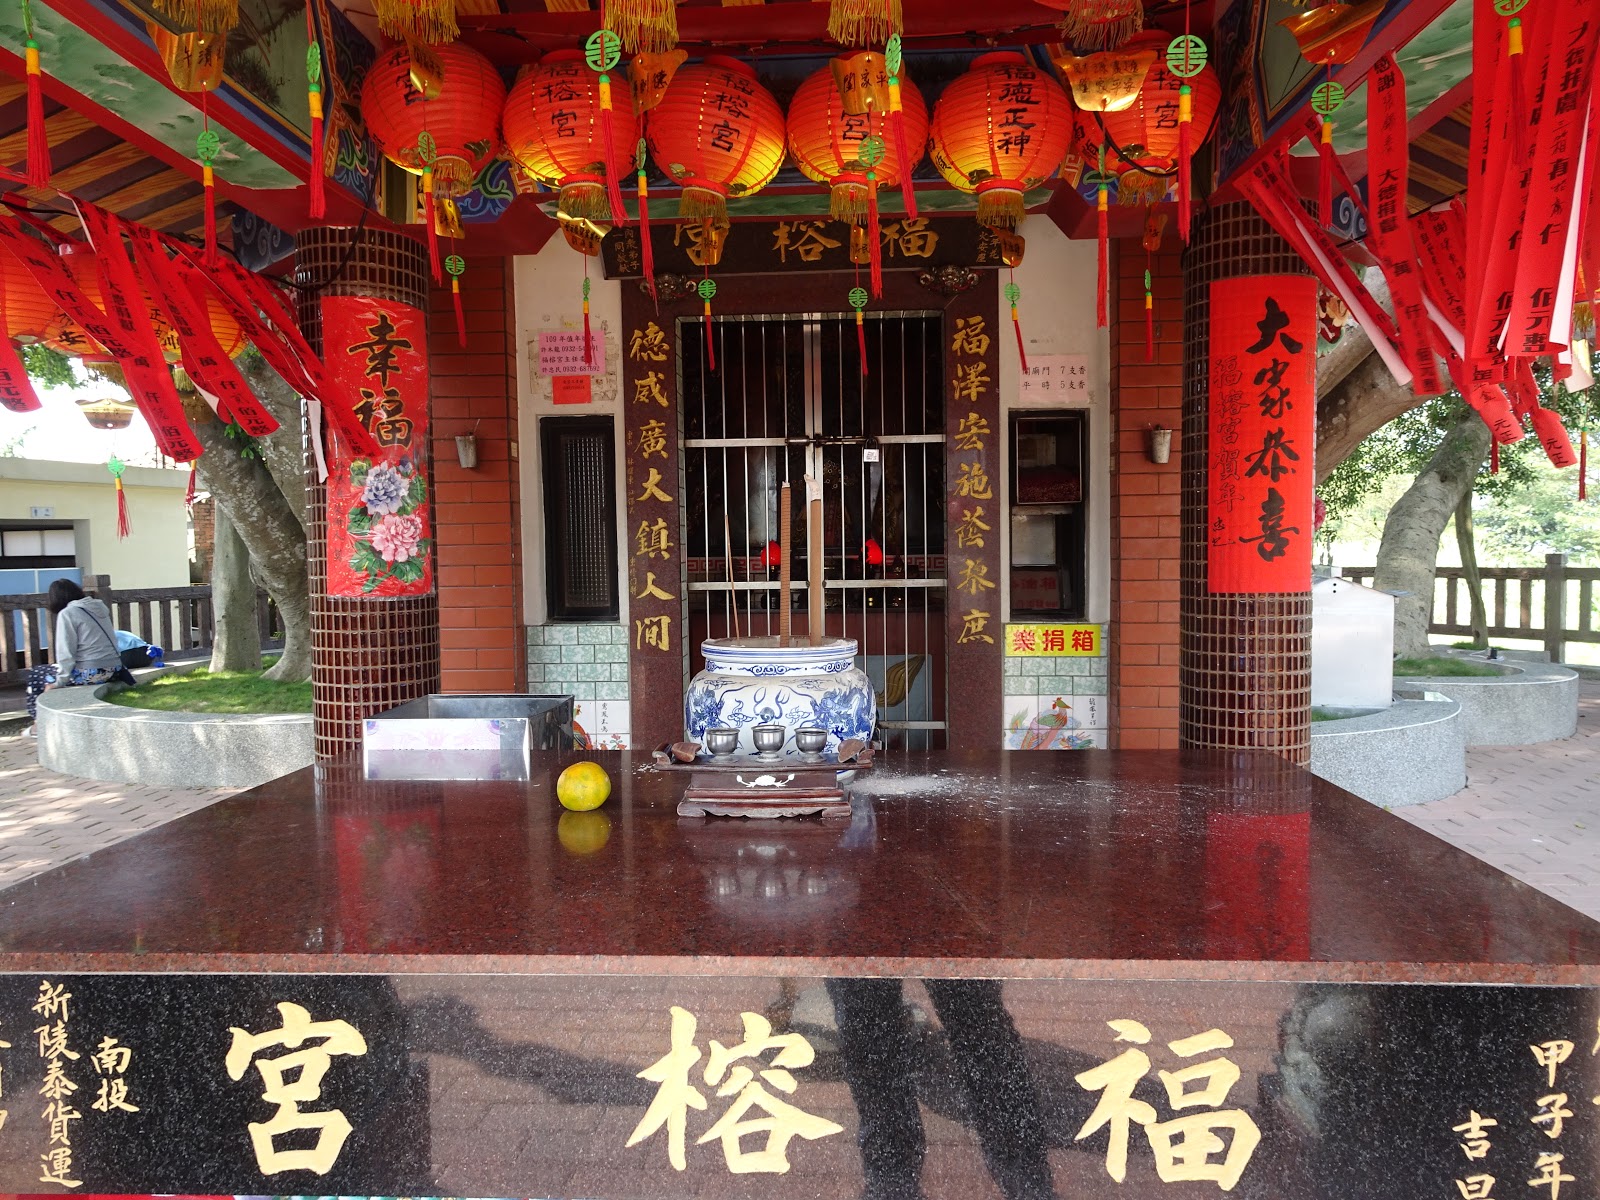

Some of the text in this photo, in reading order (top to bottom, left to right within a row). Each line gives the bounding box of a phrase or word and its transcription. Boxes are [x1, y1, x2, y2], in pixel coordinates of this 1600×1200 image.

[540, 65, 583, 138] 福榕宮
[709, 73, 754, 152] 福榕宮
[994, 66, 1041, 157] 福德正神
[347, 311, 414, 449] 幸福
[1239, 296, 1304, 562] 大家恭喜
[629, 321, 676, 652] 德威廣大鎮人間
[1012, 629, 1095, 652] 樂捐箱
[91, 1036, 140, 1113] 南投
[1527, 1040, 1576, 1200] 甲子年
